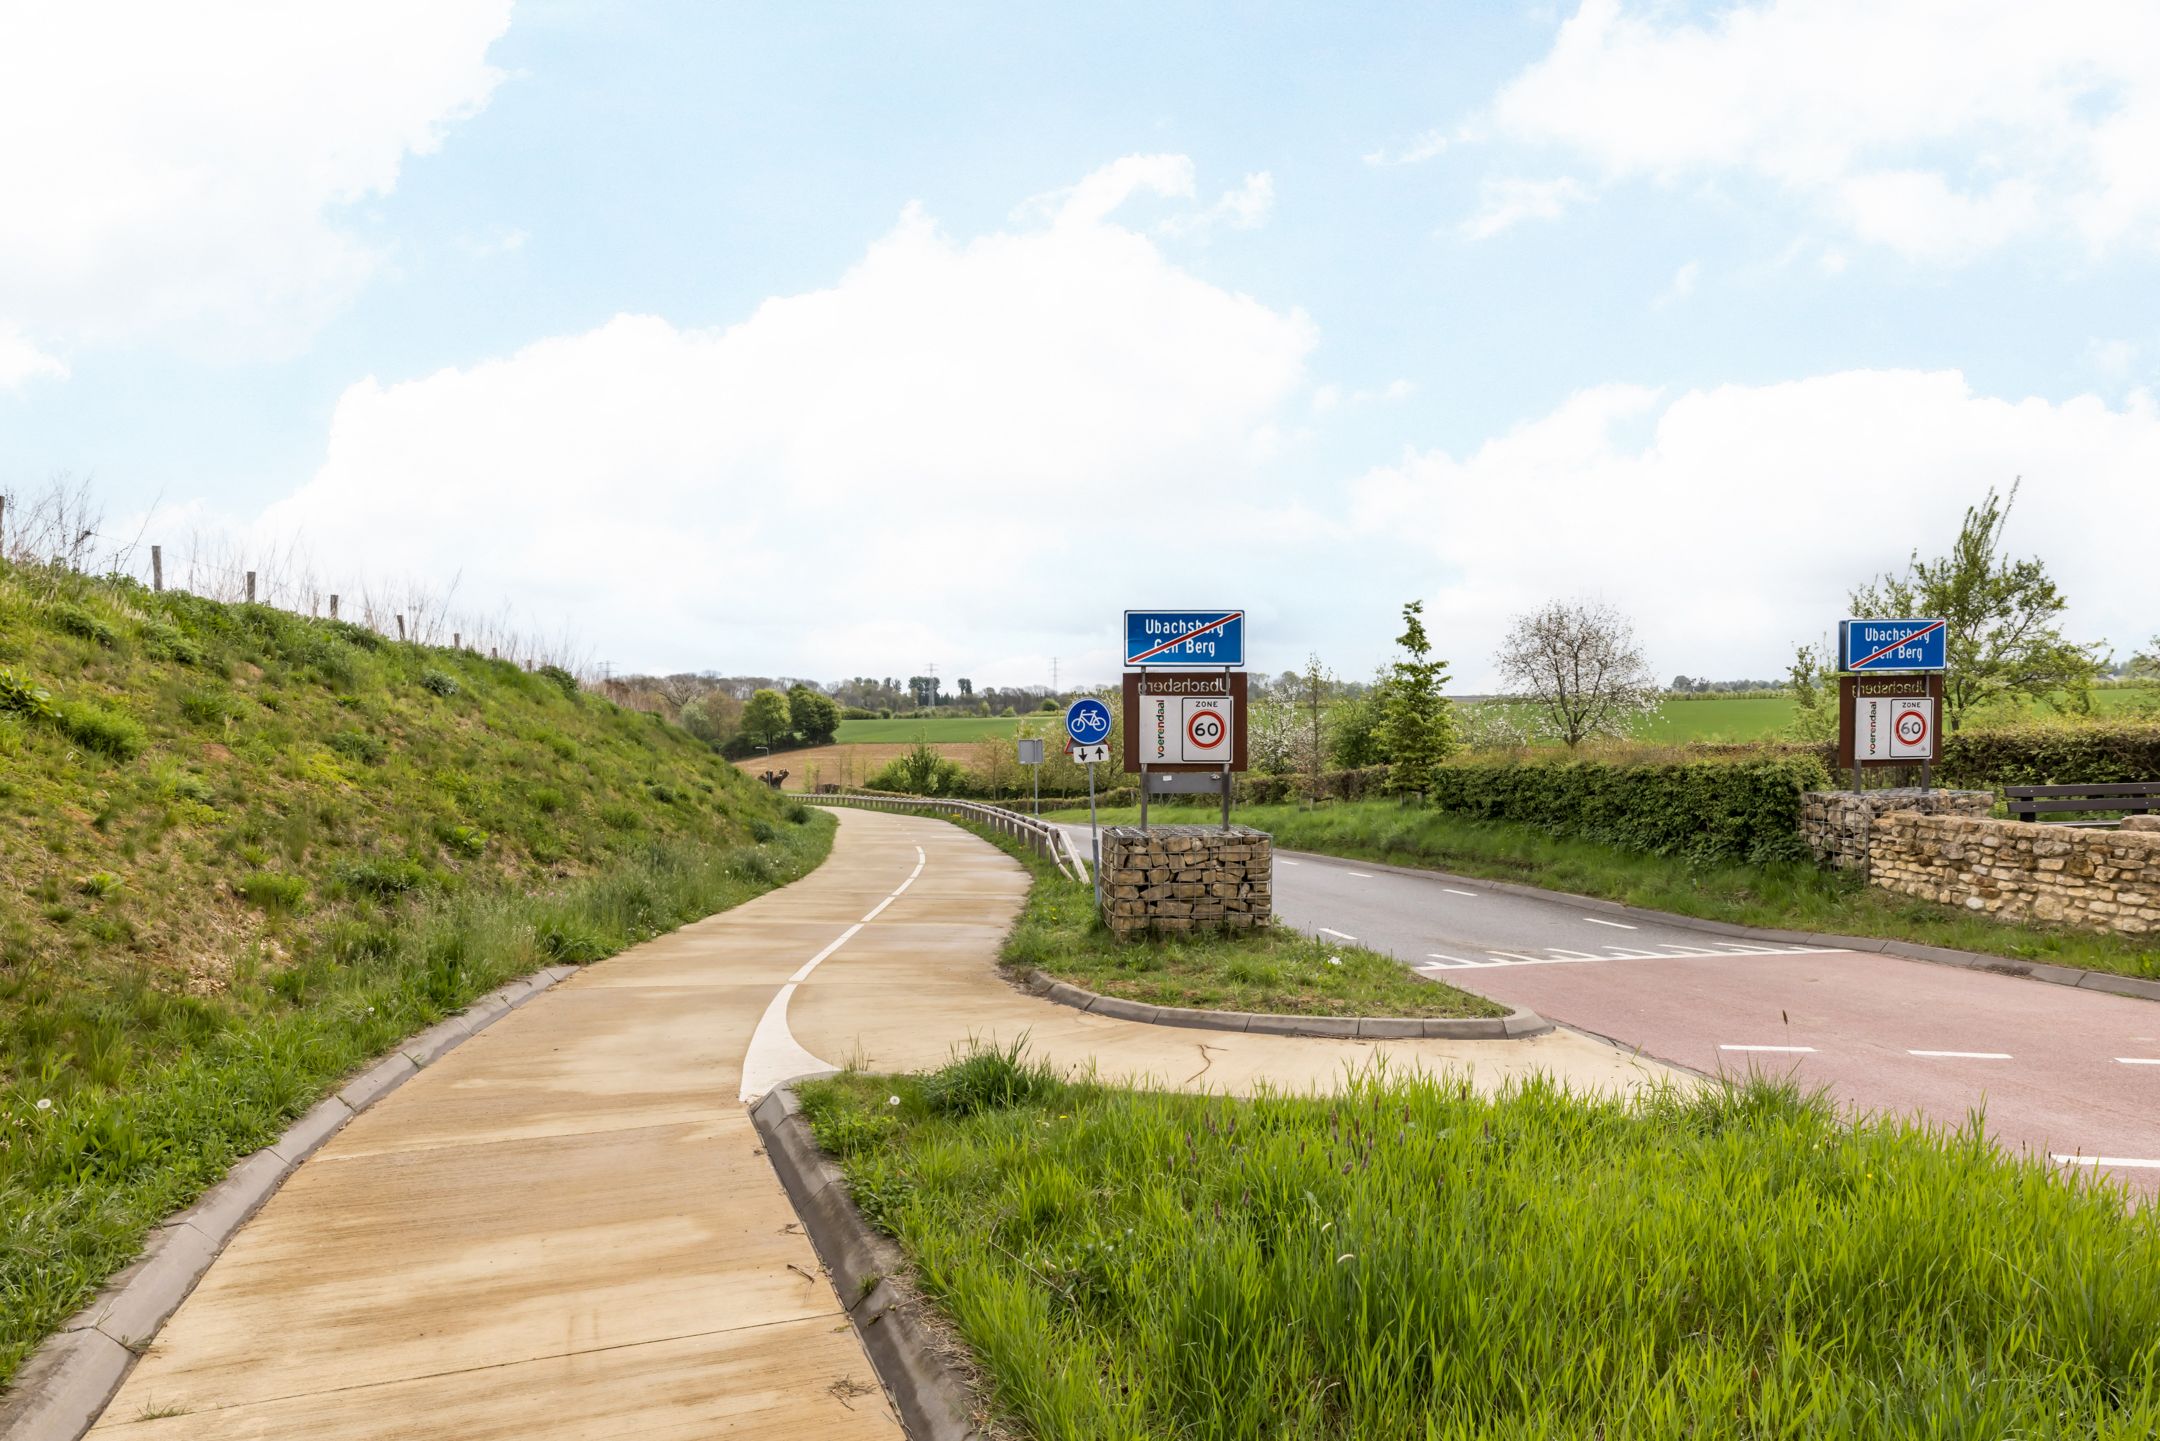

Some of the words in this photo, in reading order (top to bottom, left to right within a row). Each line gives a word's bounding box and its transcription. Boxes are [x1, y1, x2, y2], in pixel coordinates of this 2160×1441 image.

[1186, 640, 1215, 657] Berg
[1898, 645, 1923, 662] Berg
[1156, 700, 1165, 759] voerendaal
[1194, 722, 1219, 736] 60
[1869, 701, 1877, 755] voerendaal
[1900, 721, 1921, 735] 60
